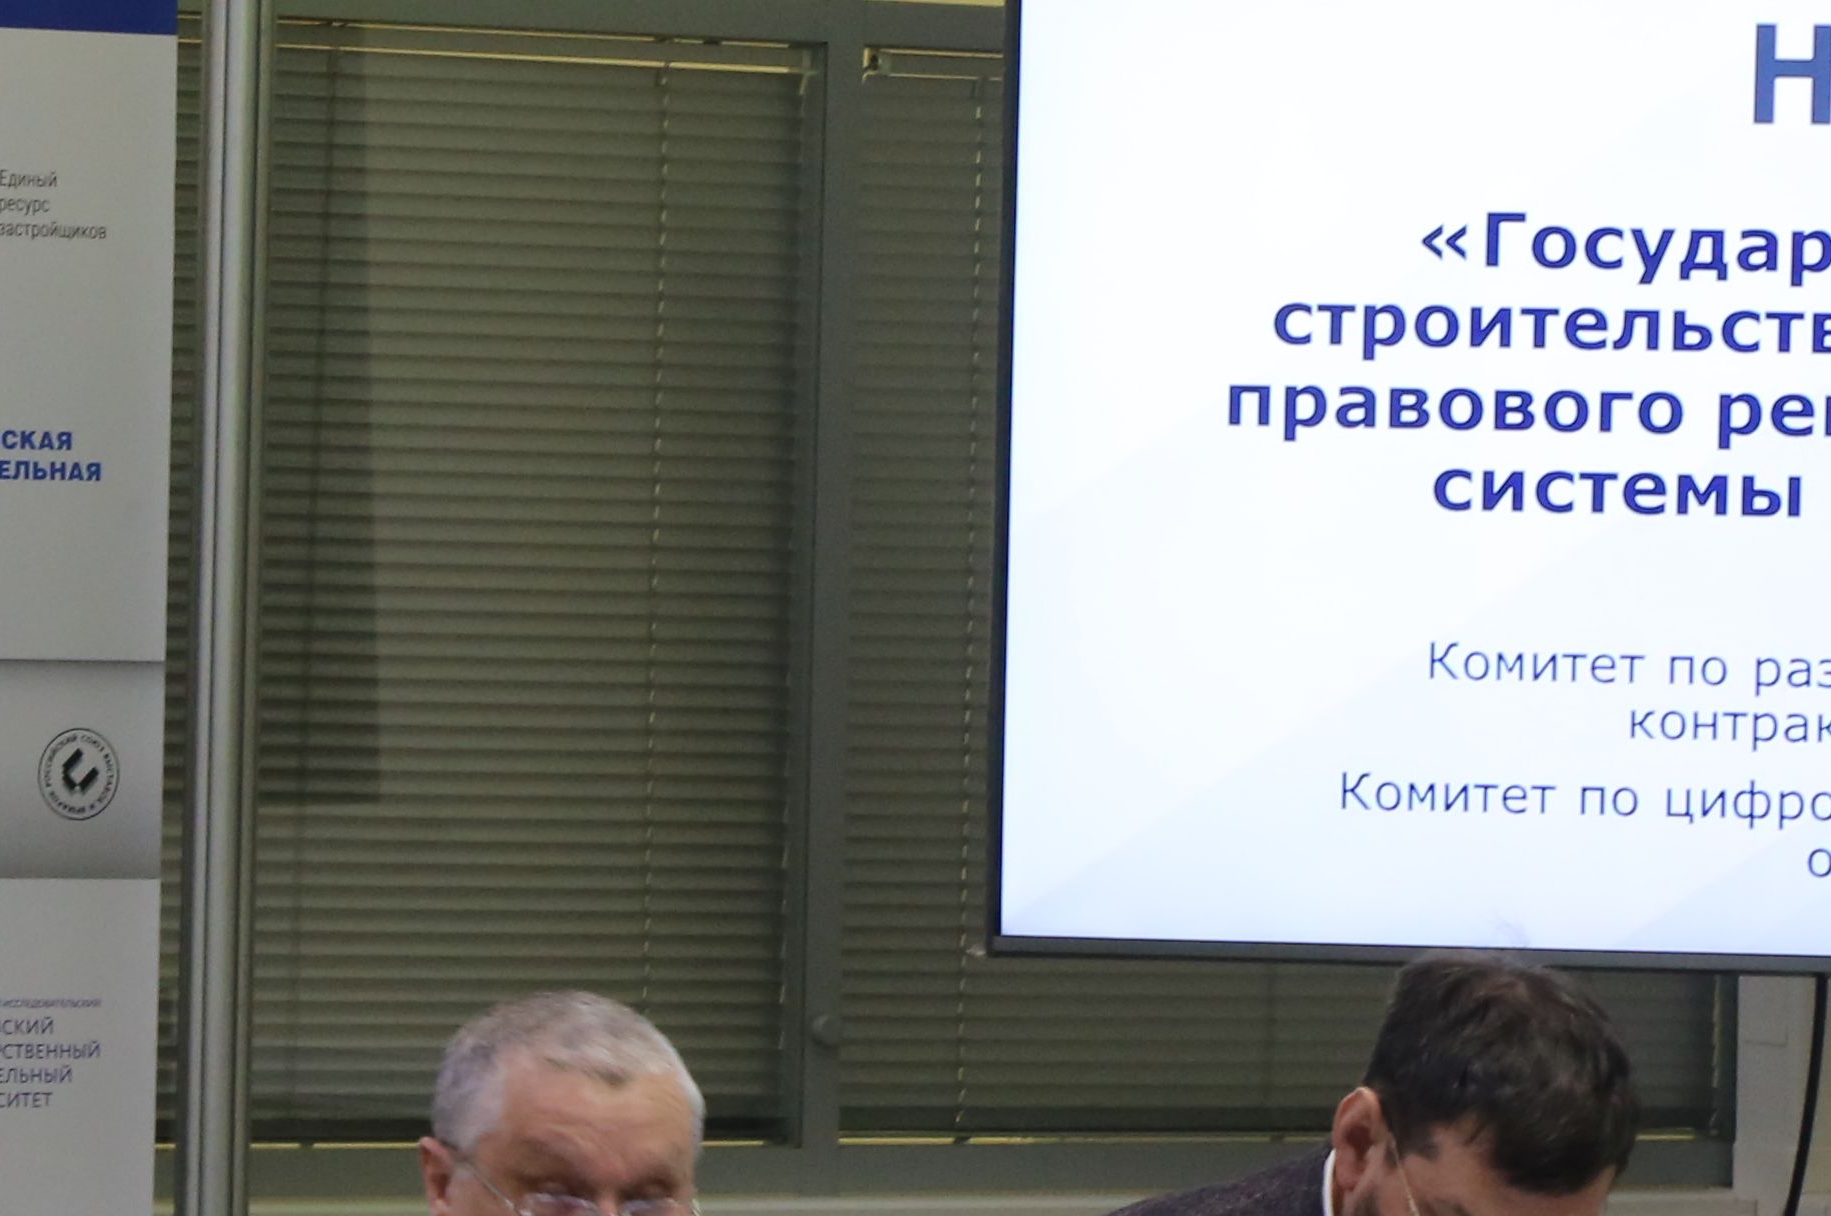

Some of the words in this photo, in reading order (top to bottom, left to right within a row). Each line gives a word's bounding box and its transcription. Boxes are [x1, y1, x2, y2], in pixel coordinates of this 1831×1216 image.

[1227, 384, 1683, 442] правового
[1433, 469, 1802, 518] системы
[1428, 641, 1646, 684] Комитет
[1669, 656, 1728, 686] по
[1340, 771, 1556, 815] Комитет
[1580, 786, 1639, 817] по
